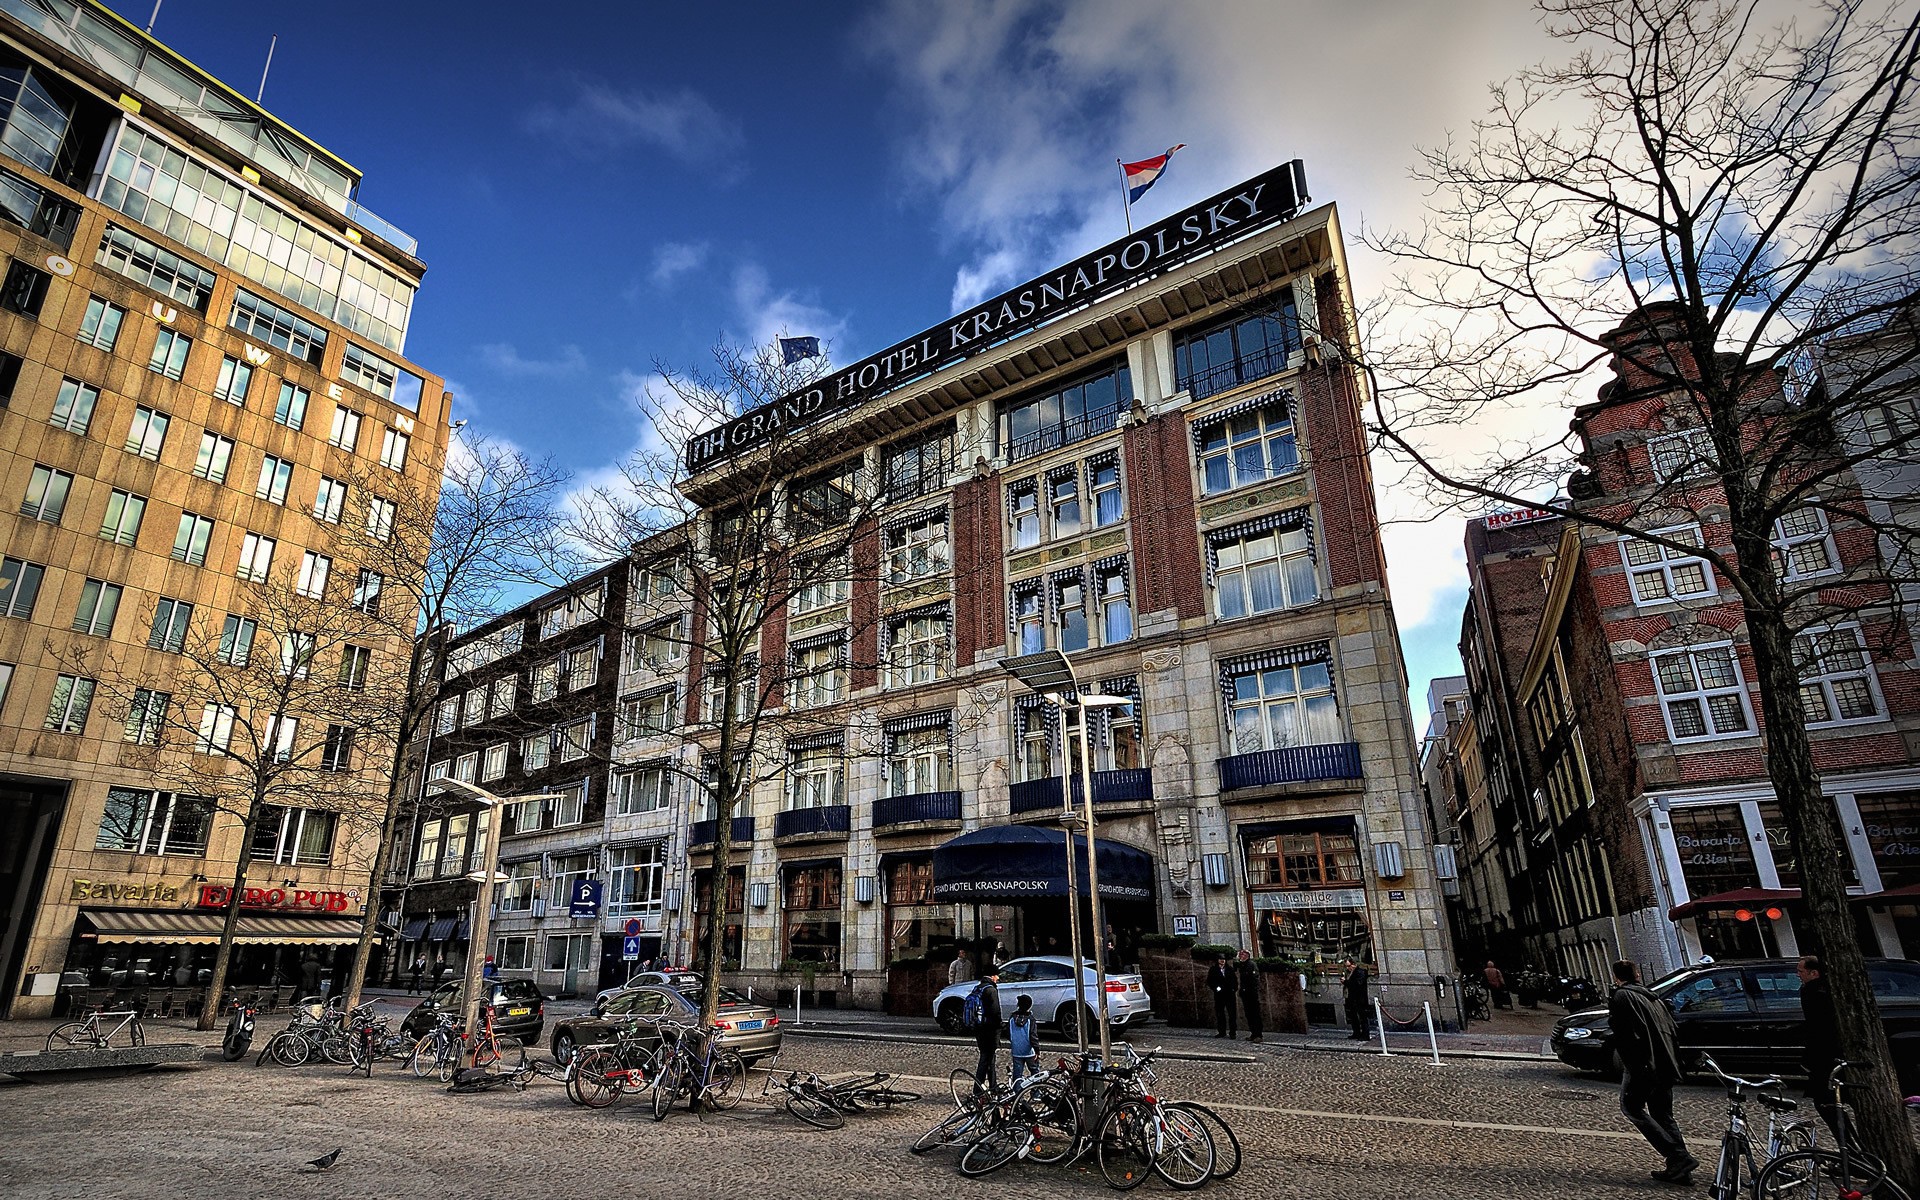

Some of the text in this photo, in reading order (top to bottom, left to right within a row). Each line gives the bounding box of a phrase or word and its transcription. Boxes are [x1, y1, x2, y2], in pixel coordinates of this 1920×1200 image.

[731, 389, 824, 446] GRAND
[836, 336, 940, 401] HOTEL
[949, 182, 1266, 350] KRASNAPOLSKY
[1677, 834, 1744, 848] Bavaria
[70, 879, 179, 902] Bavaria
[949, 881, 973, 892] HOTEL
[975, 880, 1049, 890] KRASNAPOLSKY
[581, 889, 591, 900] P
[1282, 891, 1334, 904] Mathilde
